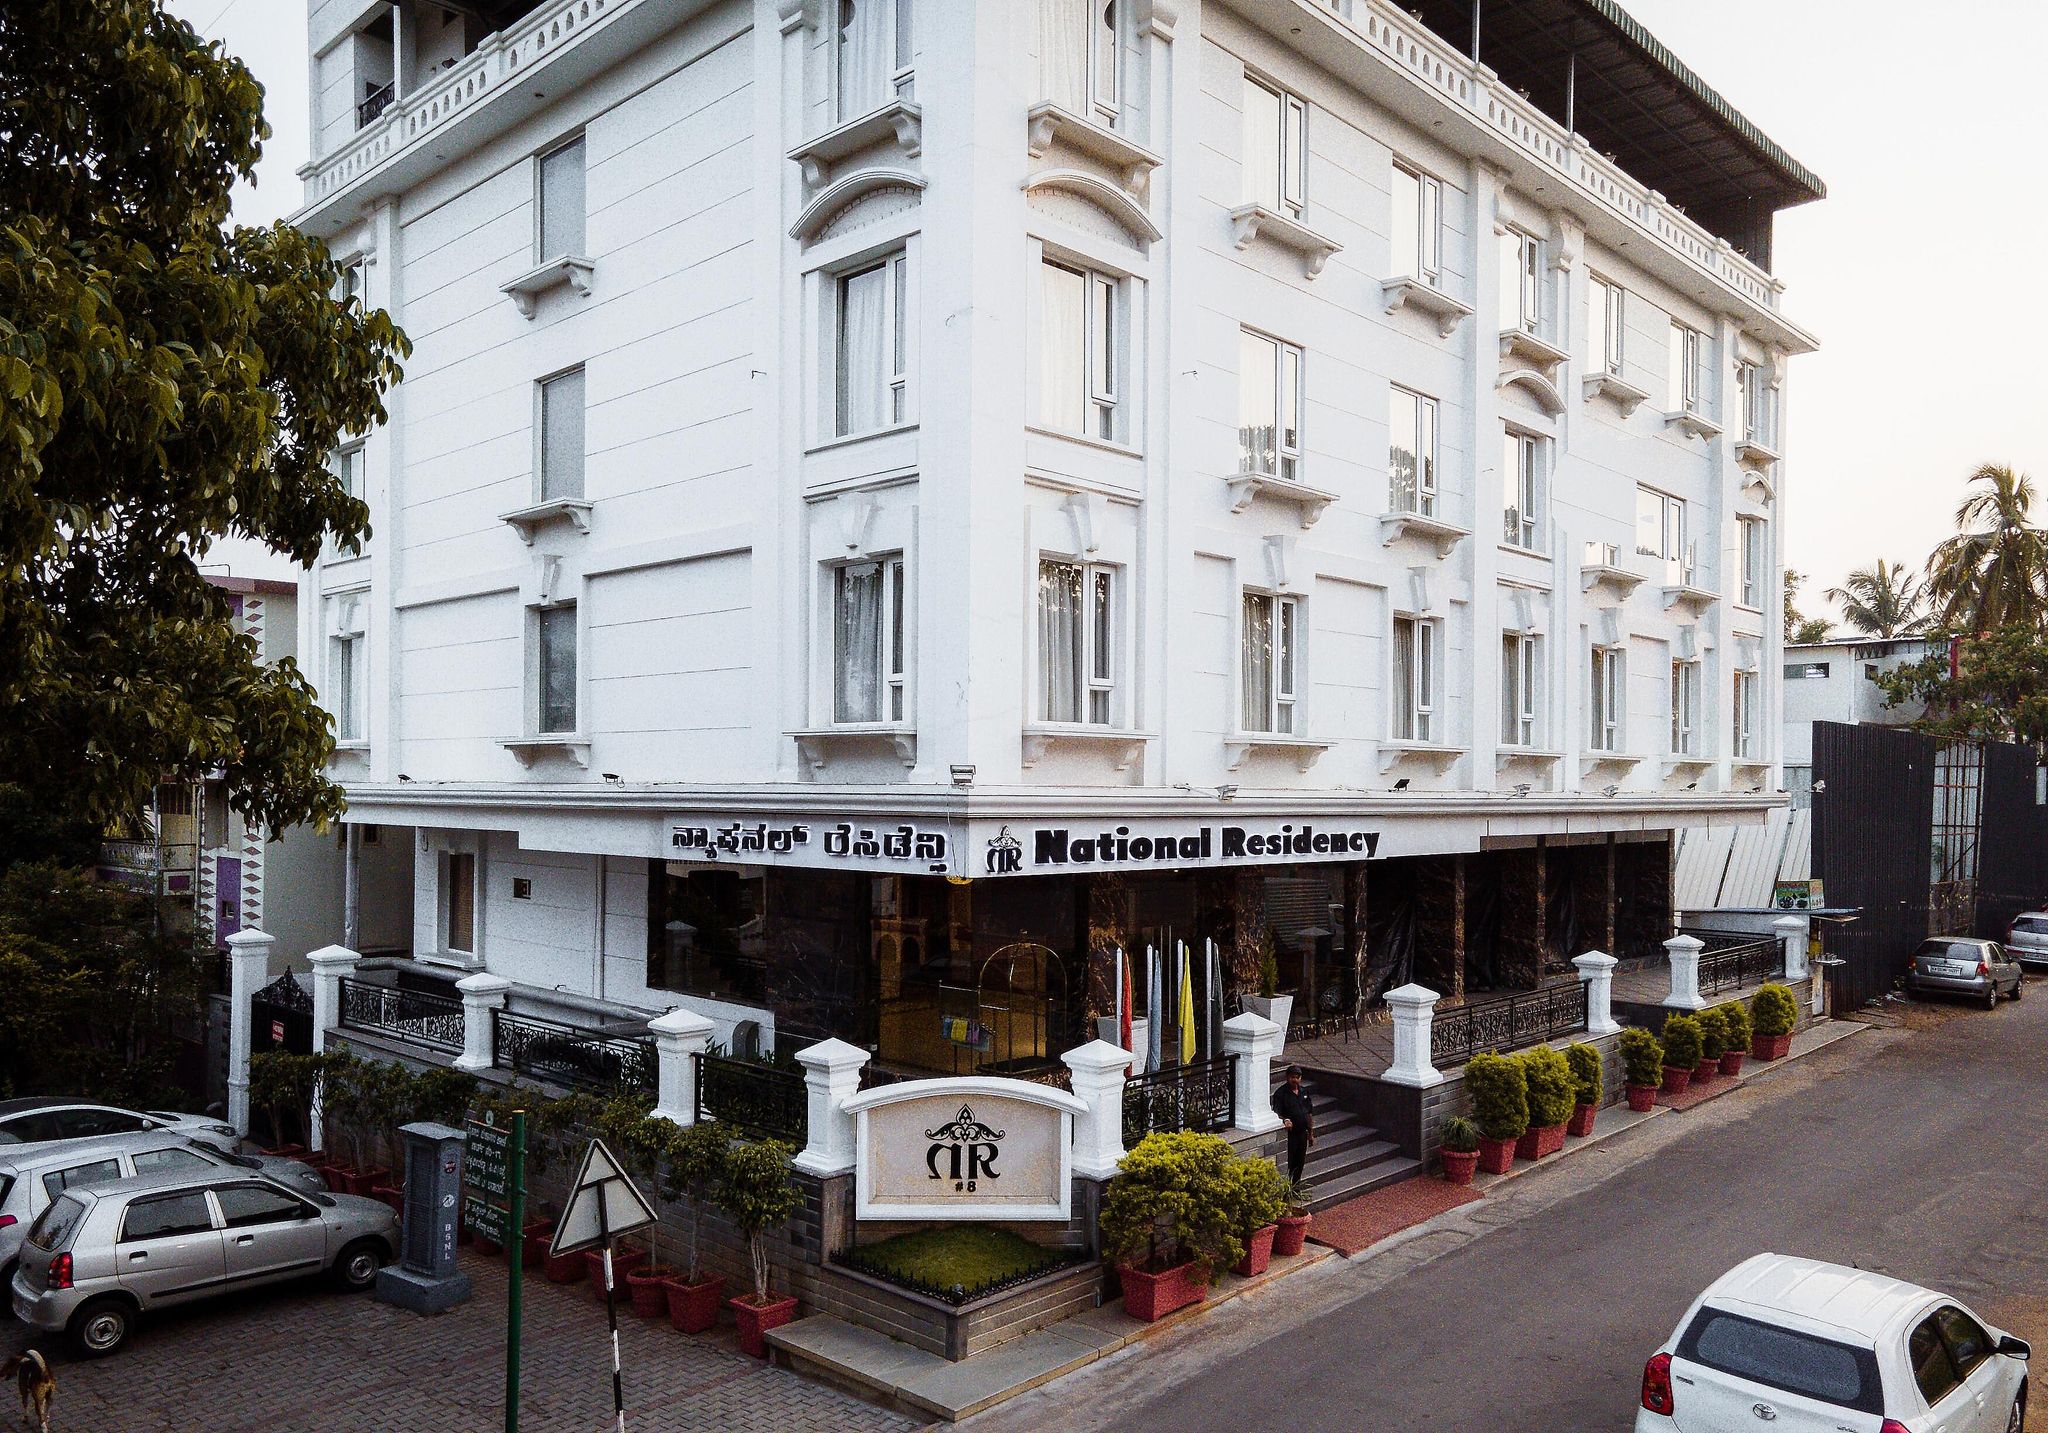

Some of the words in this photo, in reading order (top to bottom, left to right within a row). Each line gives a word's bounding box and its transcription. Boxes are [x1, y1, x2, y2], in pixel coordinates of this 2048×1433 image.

[1034, 826, 1212, 864] National
[1222, 824, 1381, 858] Residency
[443, 1223, 452, 1261] BSNL
